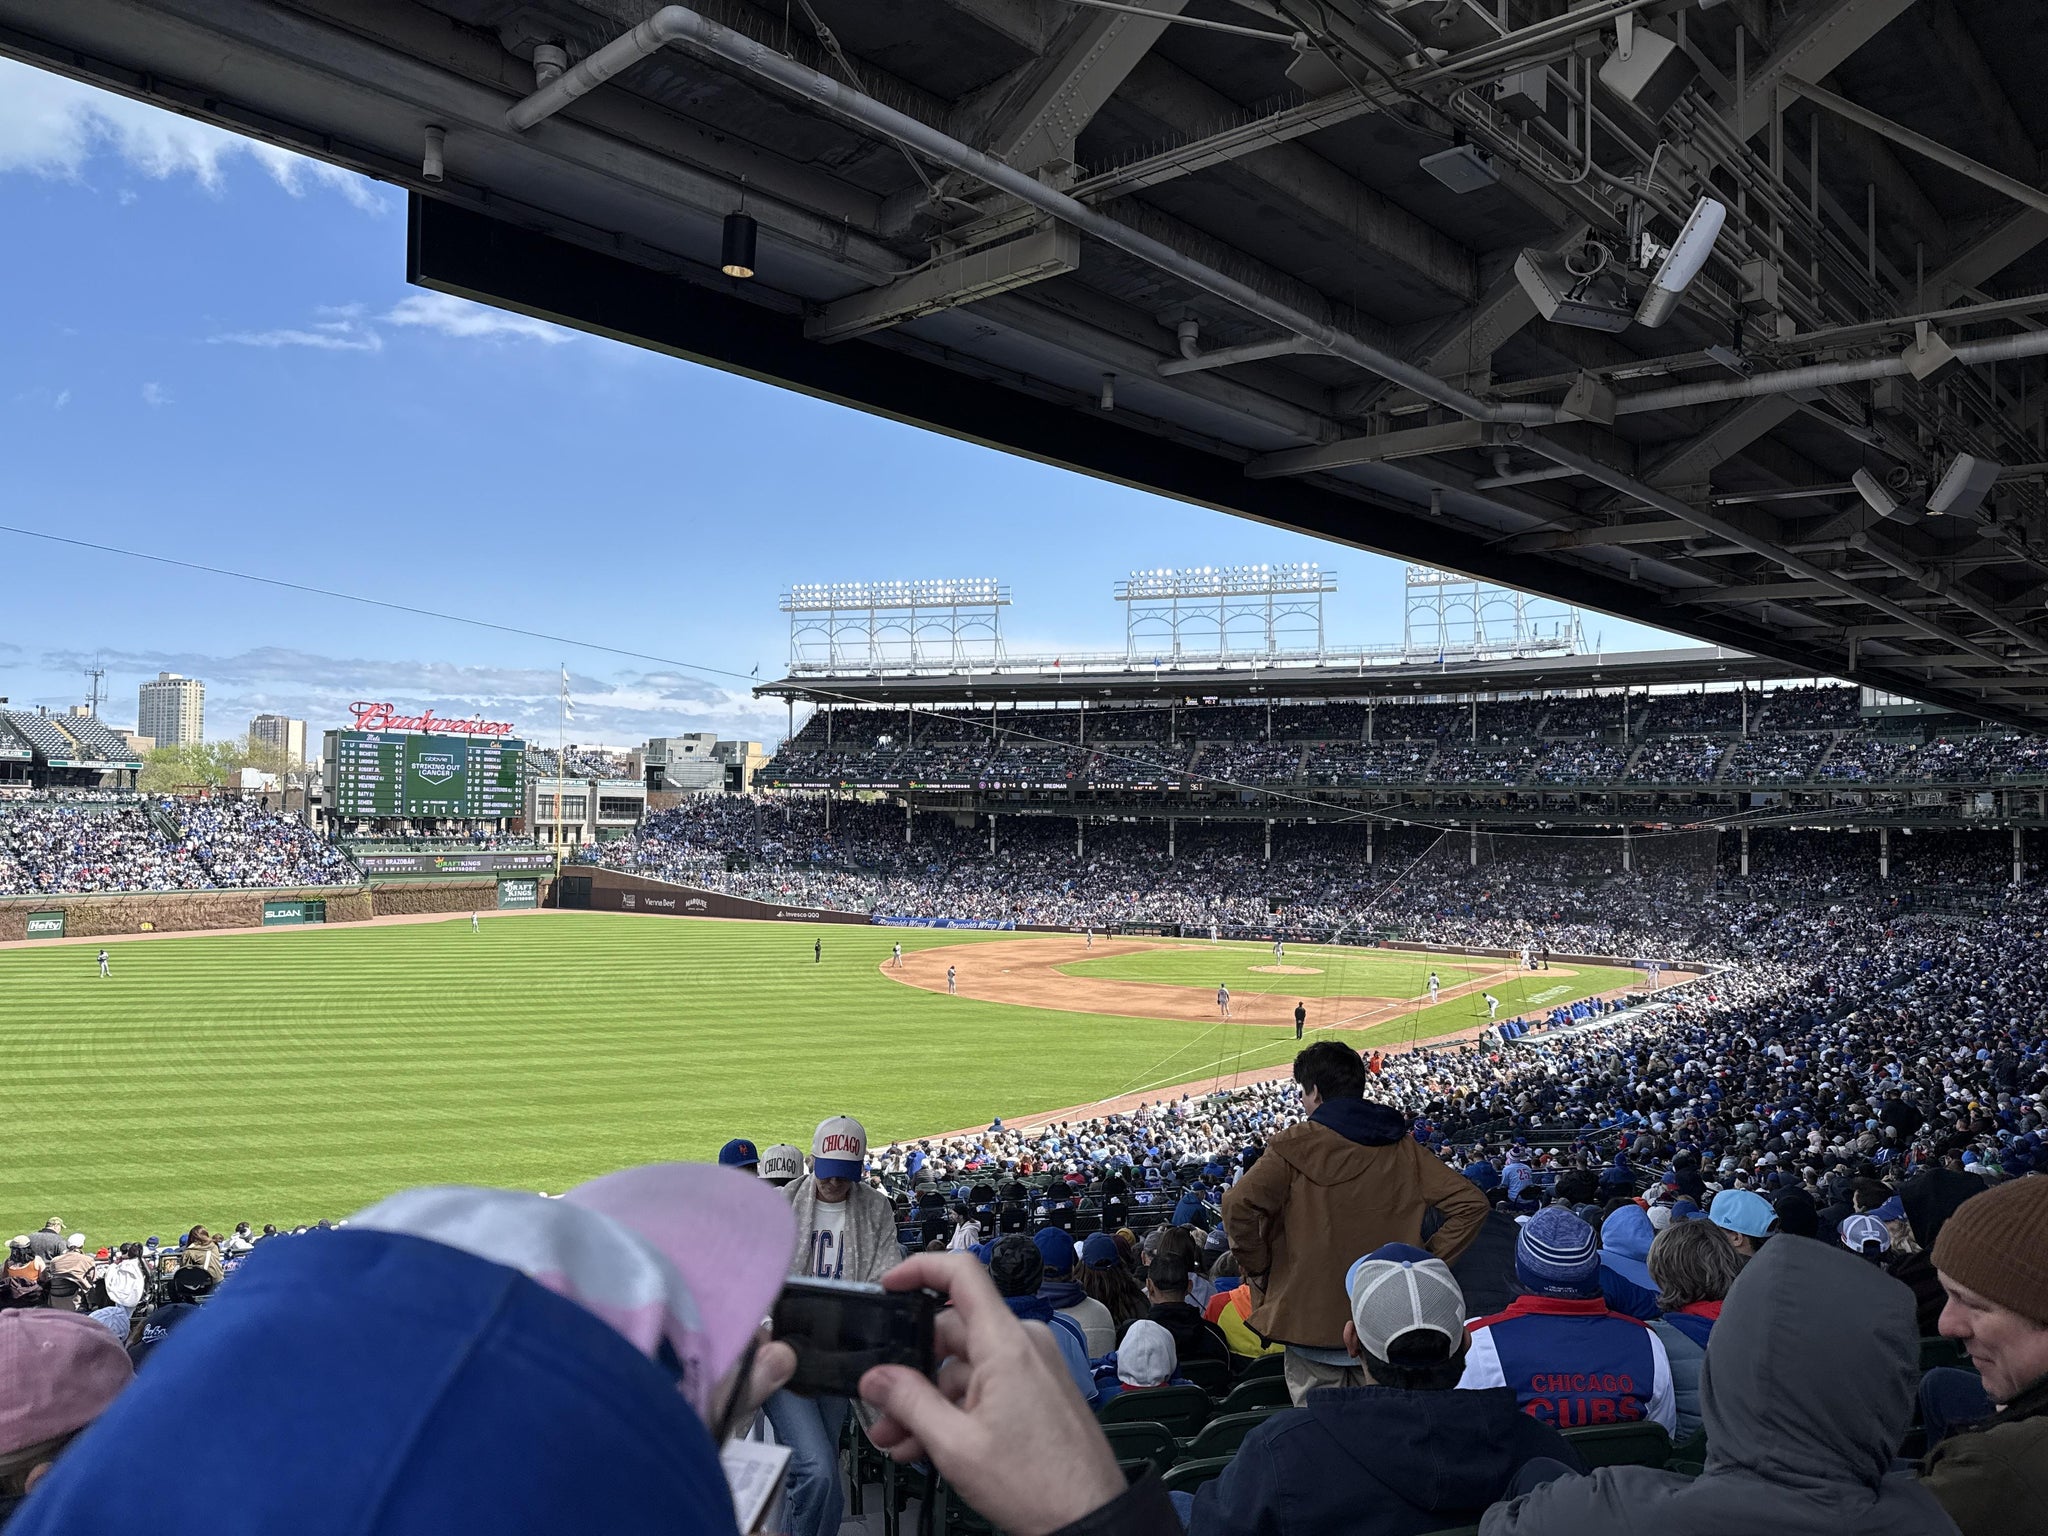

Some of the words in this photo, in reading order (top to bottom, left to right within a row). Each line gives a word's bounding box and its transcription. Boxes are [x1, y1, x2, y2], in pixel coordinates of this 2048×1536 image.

[349, 702, 514, 736] Budweiser
[644, 898, 662, 906] Vienna
[662, 898, 676, 908] Beef
[686, 898, 707, 908] MARQUEE
[30, 921, 60, 930] Hefty
[878, 919, 908, 928] Reynolds
[908, 920, 926, 928] Wrap
[978, 922, 996, 930] Wrap
[822, 1134, 860, 1156] CHICAGO
[765, 1157, 796, 1174] CHICAGO
[1517, 1169, 1530, 1180] 25
[1532, 1374, 1633, 1392] CHICAGO
[1525, 1396, 1640, 1428] CUBS
